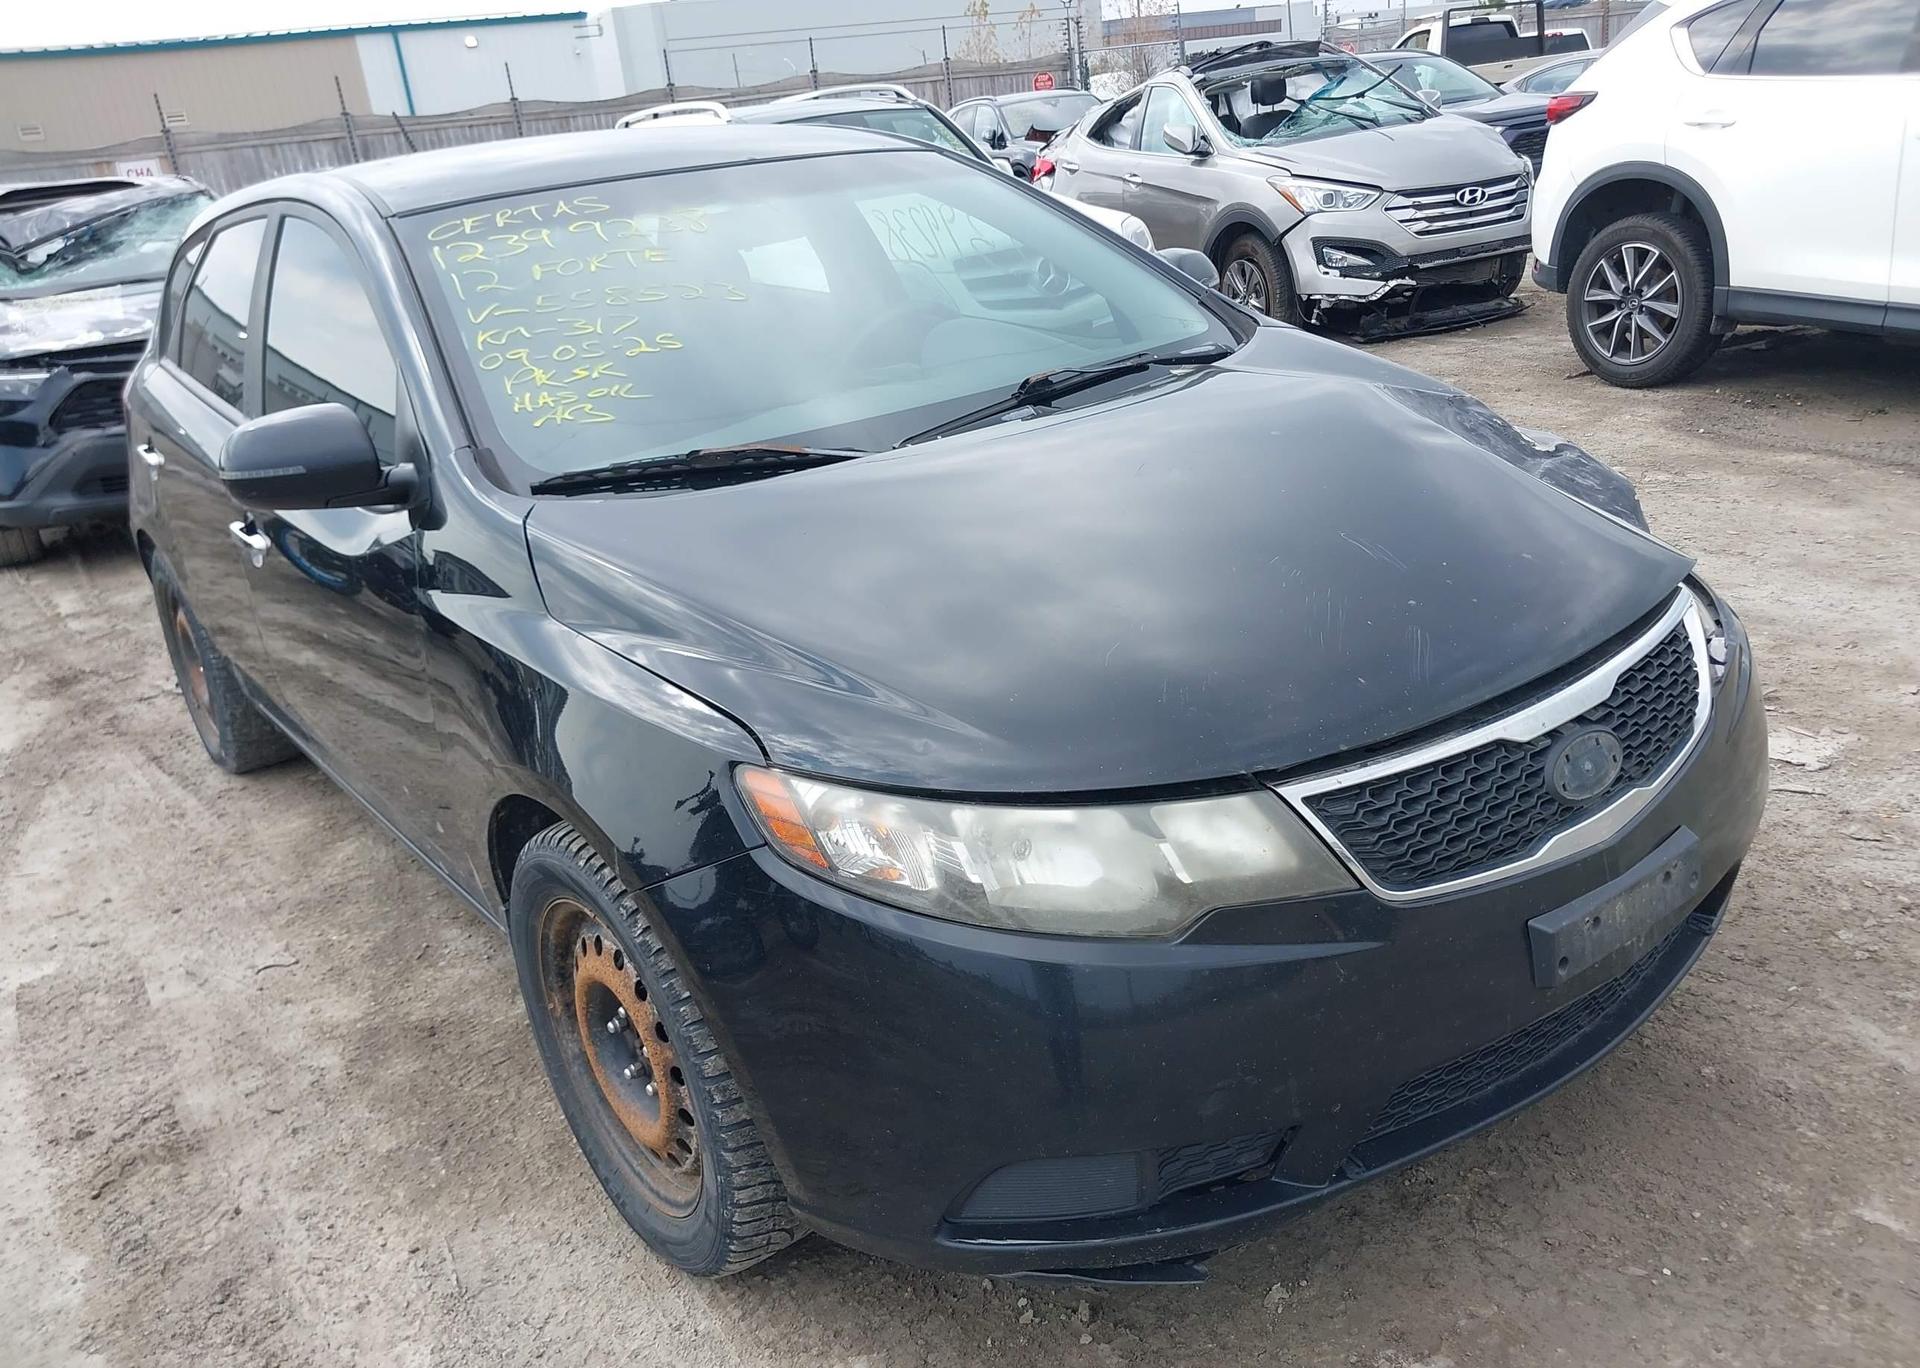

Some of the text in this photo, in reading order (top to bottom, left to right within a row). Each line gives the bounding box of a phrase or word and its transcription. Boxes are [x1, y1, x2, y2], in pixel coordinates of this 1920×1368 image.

[427, 196, 611, 242] CERTAS
[433, 228, 556, 270] 1239
[451, 269, 517, 300] 12
